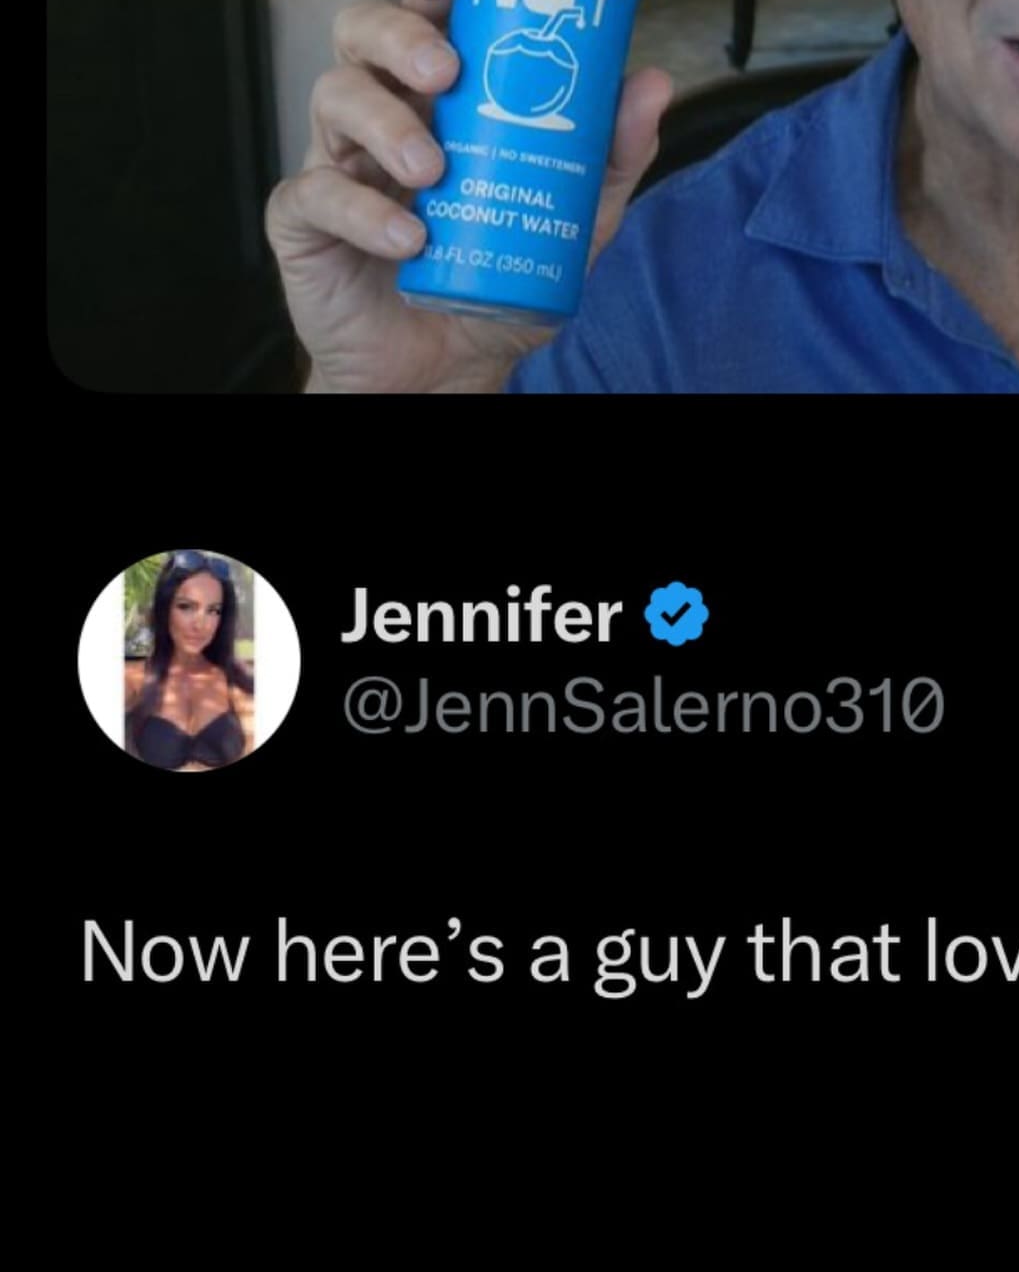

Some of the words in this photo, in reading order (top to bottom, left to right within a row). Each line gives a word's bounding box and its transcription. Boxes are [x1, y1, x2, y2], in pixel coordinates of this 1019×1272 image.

[499, 147, 518, 161] NO
[460, 178, 555, 210] ORIGINAL
[426, 200, 519, 229] COCONUT
[521, 214, 580, 241] WATER
[496, 254, 534, 276] (350
